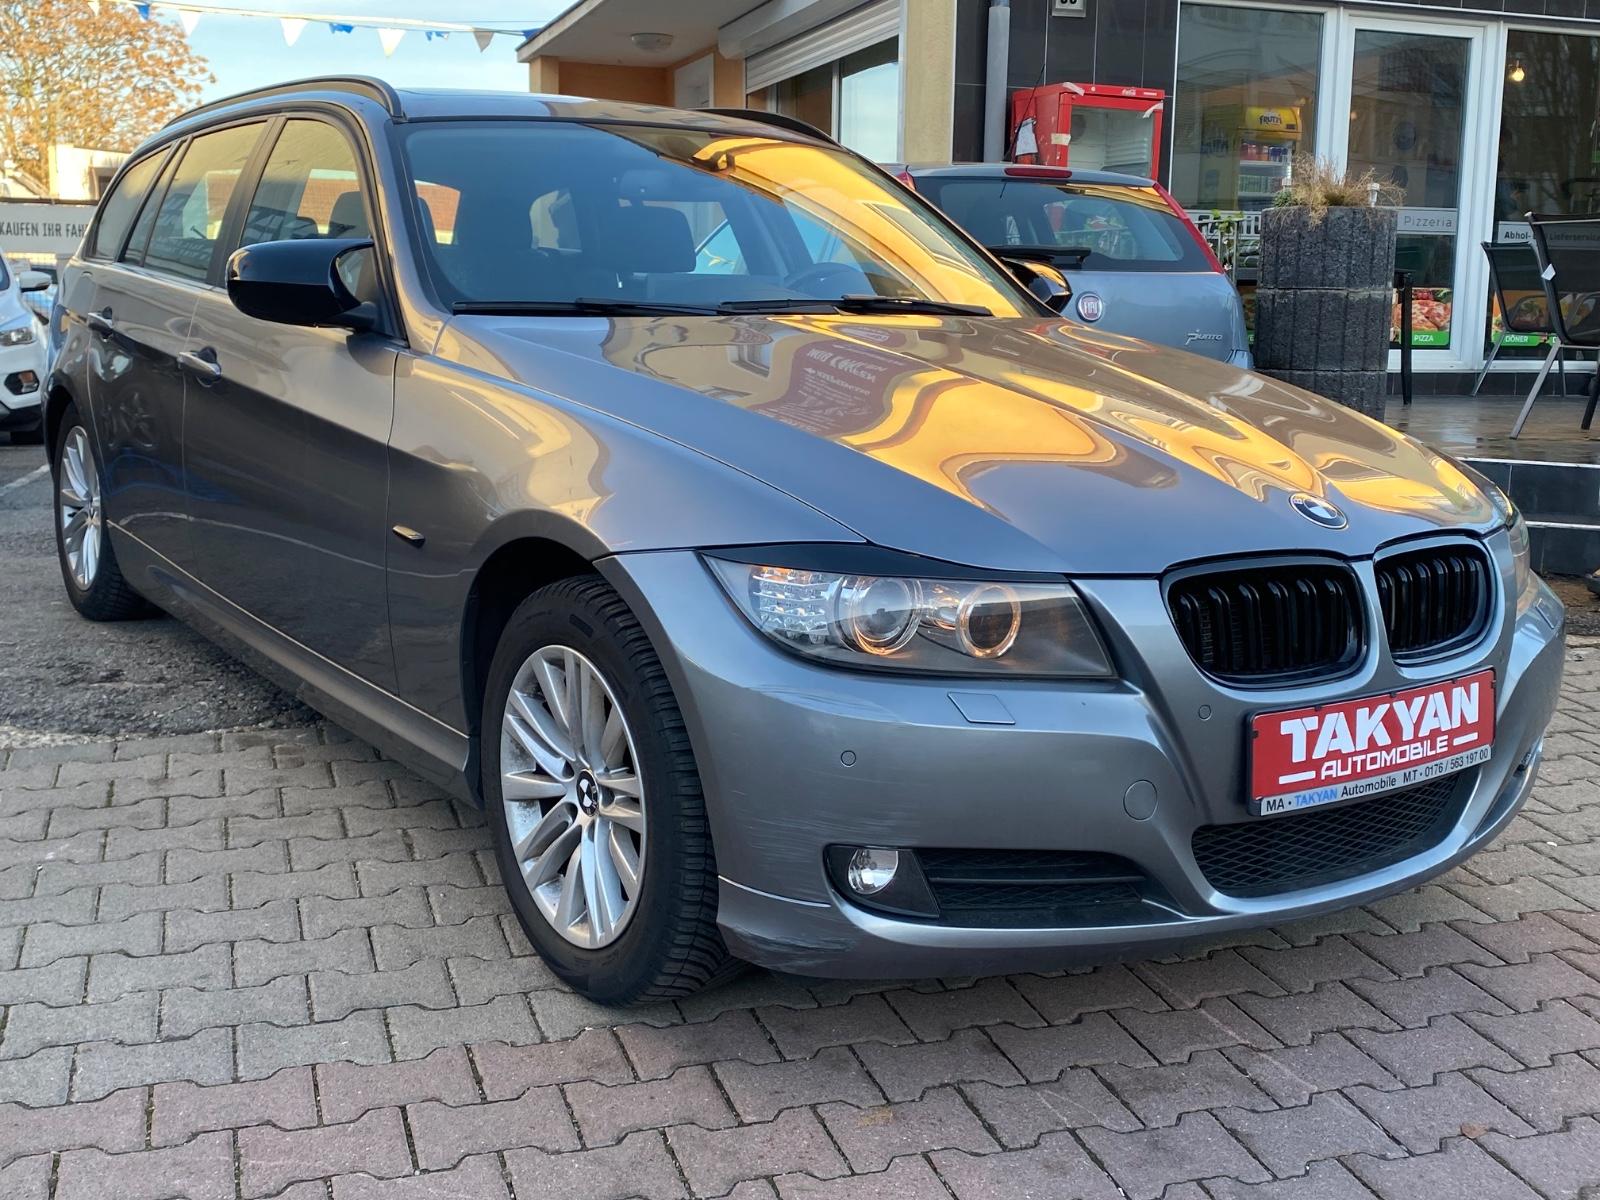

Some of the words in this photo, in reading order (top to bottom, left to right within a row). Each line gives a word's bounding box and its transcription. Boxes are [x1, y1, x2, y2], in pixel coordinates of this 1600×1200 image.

[1404, 215, 1452, 228] Pizzeria
[0, 222, 39, 236] KAUFEN
[43, 222, 62, 237] IHR
[66, 223, 88, 238] FAH
[1504, 231, 1531, 240] Abhol-
[1414, 334, 1434, 342] PIZZA
[1505, 335, 1529, 343] DÖNER
[1280, 682, 1480, 763] TAKYAN
[1320, 735, 1449, 780] AUTOMOBILE
[1266, 798, 1285, 812] MA
[1294, 788, 1338, 807] TAKYAN
[1340, 775, 1397, 798] Automobile
[1424, 762, 1444, 778] 0176
[1450, 757, 1464, 770] 563
[1466, 752, 1477, 763] 197
[1479, 748, 1489, 760] 00
